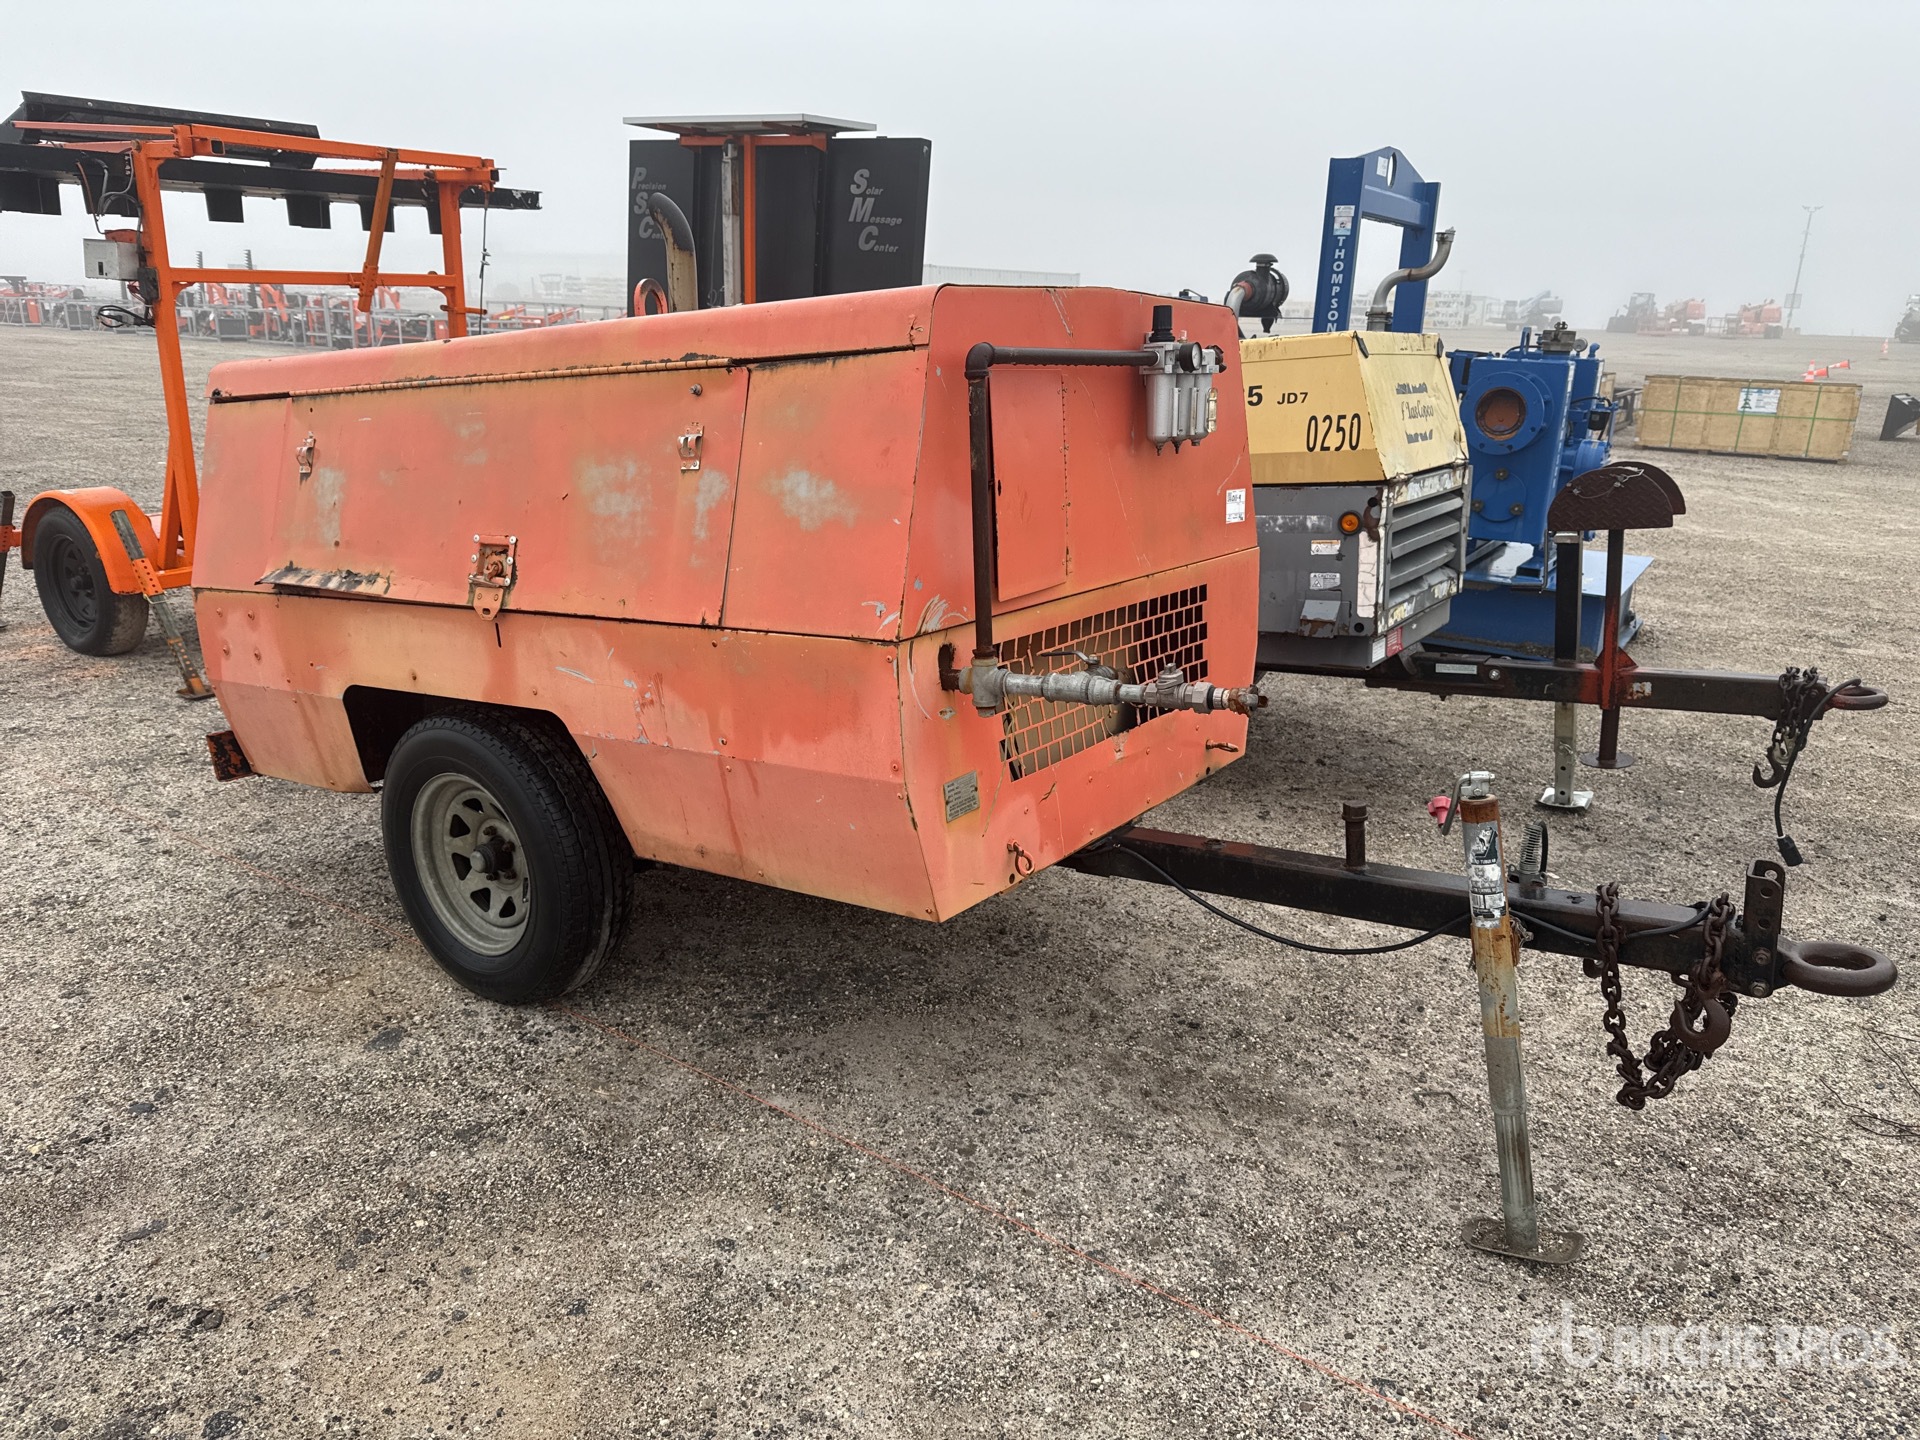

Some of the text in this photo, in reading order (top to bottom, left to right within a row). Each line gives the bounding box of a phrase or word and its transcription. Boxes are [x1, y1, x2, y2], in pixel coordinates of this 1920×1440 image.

[631, 167, 667, 190] Precision
[850, 168, 884, 195] Solar
[848, 197, 903, 226] Message
[858, 225, 899, 252] Center
[1326, 236, 1346, 332] THOMPSON
[1276, 391, 1309, 405] JD7
[1306, 412, 1362, 453] 0250
